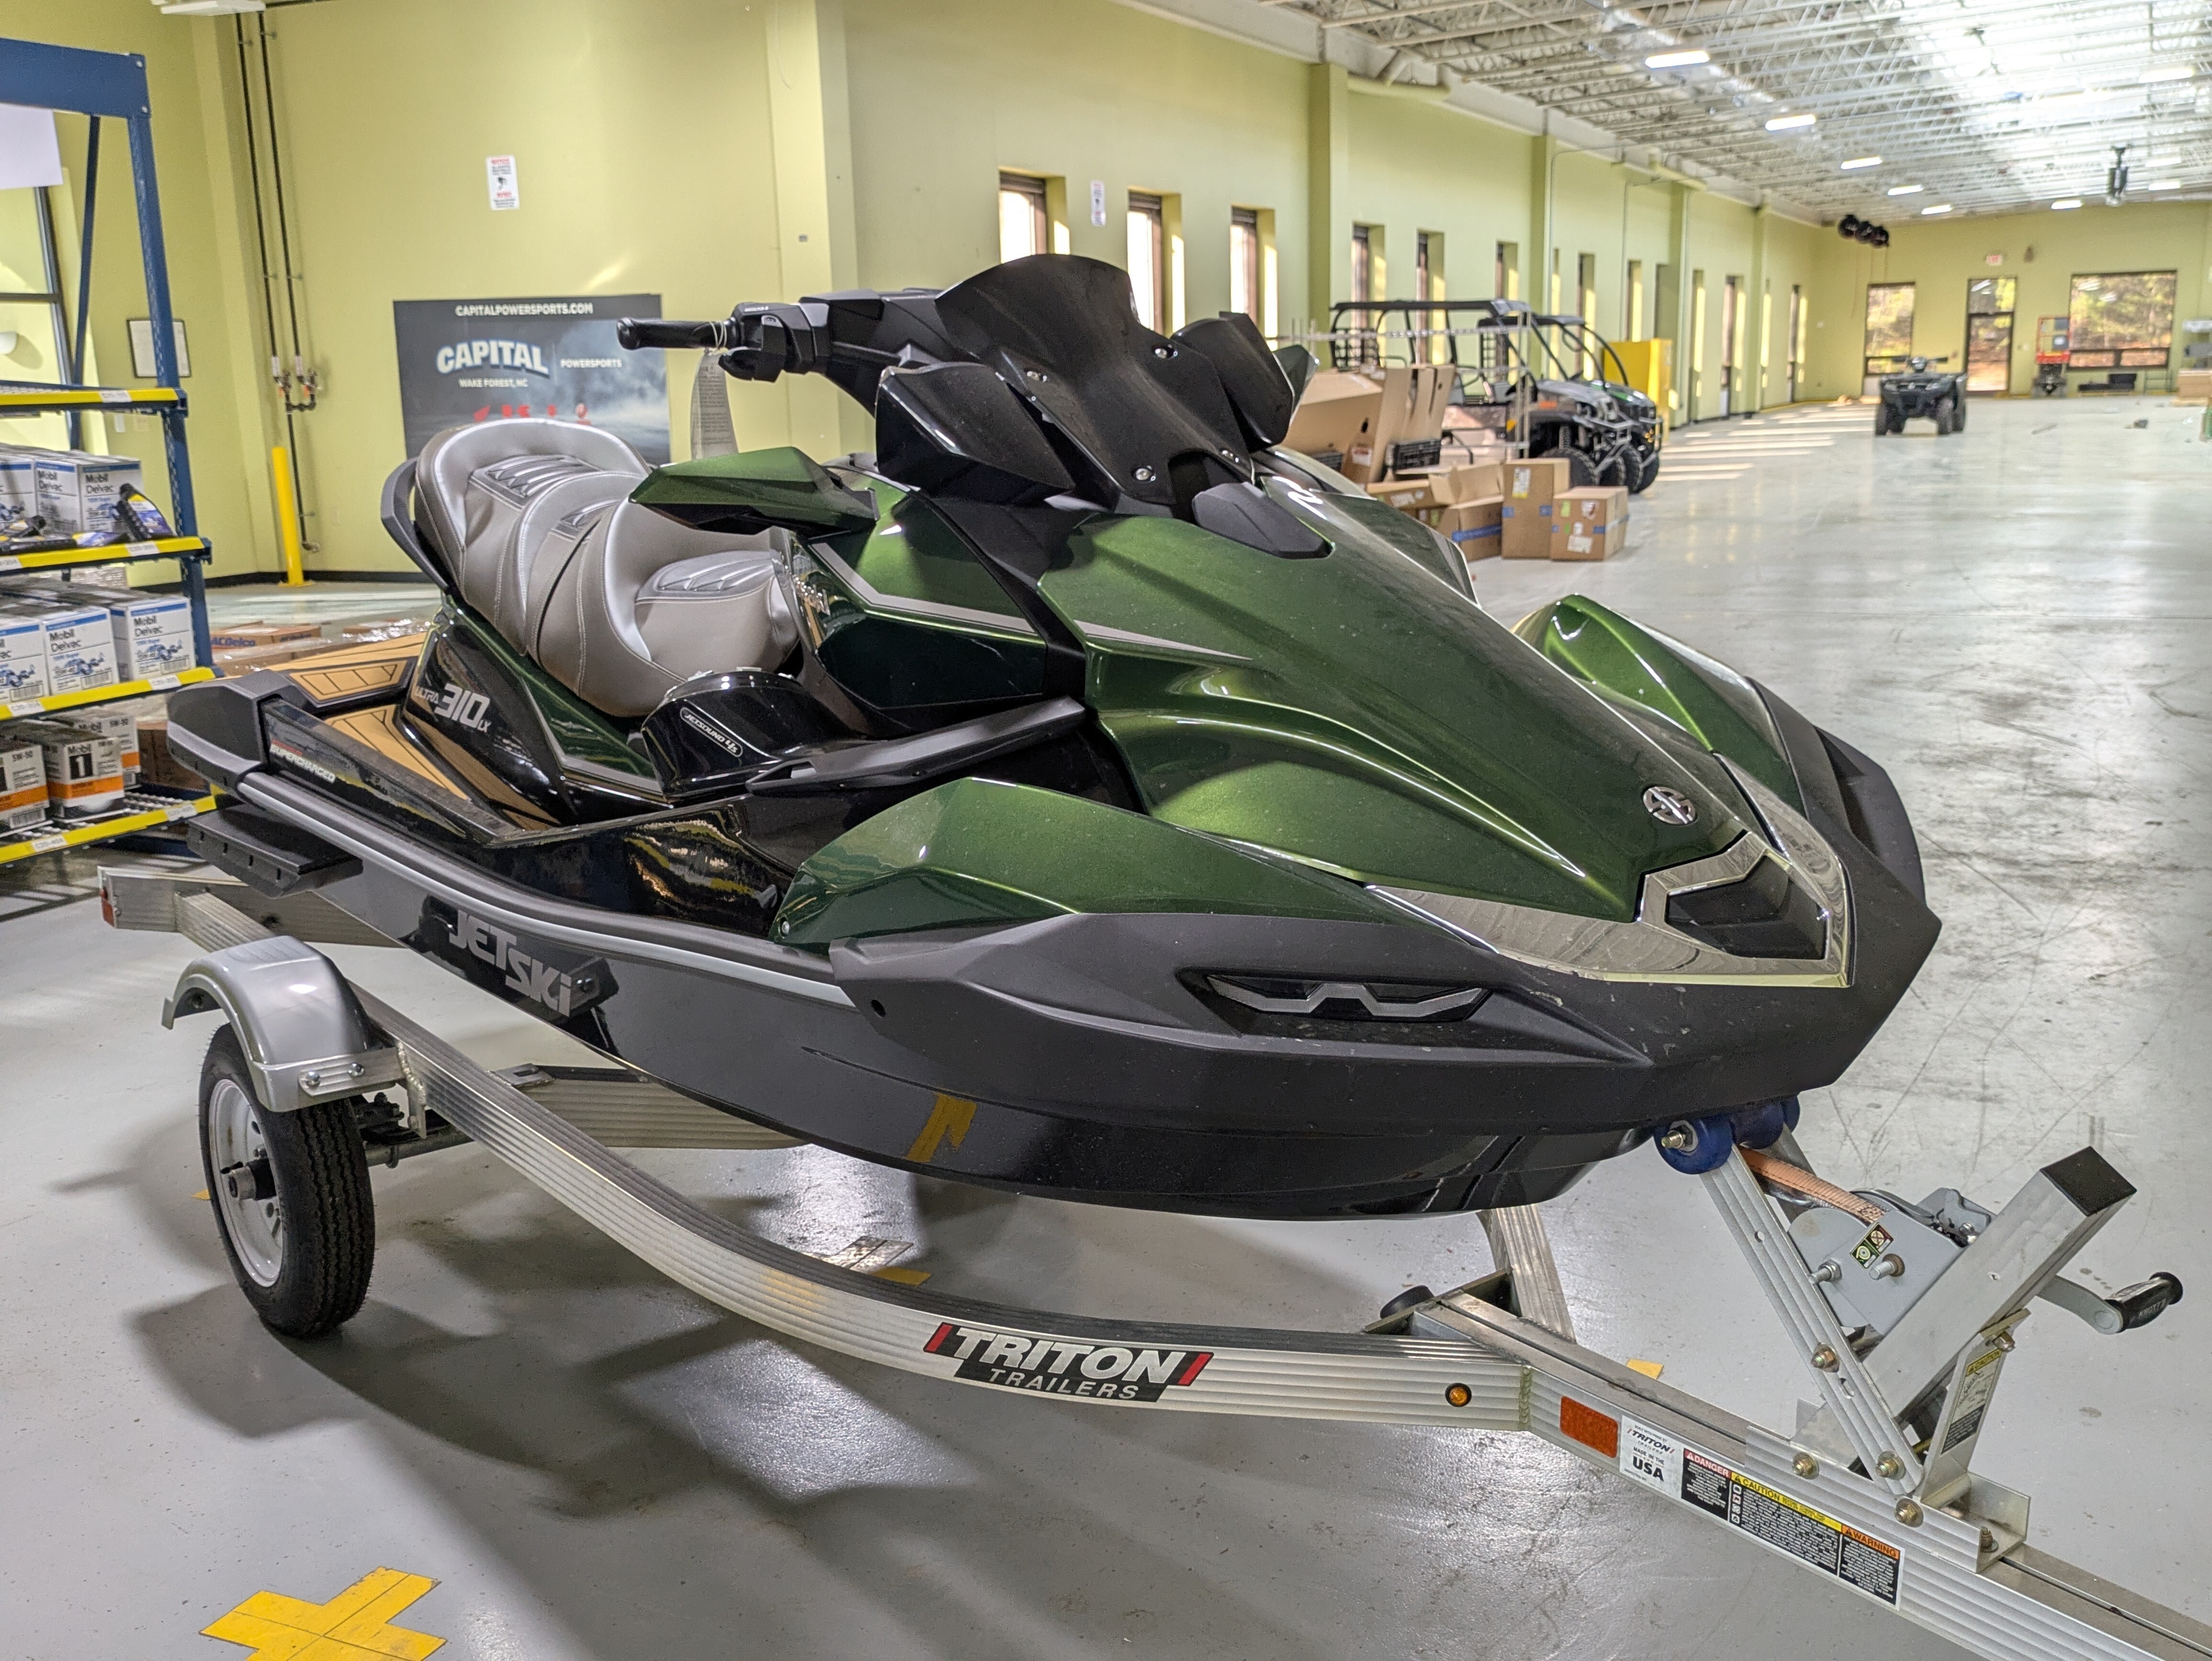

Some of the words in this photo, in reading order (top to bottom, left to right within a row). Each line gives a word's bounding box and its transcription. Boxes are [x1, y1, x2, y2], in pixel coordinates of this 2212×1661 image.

[455, 302, 593, 317] CAPITALPOWERSPORTS.COM
[436, 340, 550, 378] CAPITAL
[560, 358, 622, 368] POWERSPORTS
[458, 378, 482, 388] WAKE
[484, 378, 516, 388] FOREST,
[516, 377, 528, 388] NC
[38, 470, 58, 481] Mobil
[85, 473, 109, 483] Mobil
[38, 479, 63, 492] Delvac
[86, 485, 115, 494] Delvac
[133, 615, 157, 626] Mobil
[49, 629, 76, 641] Mobil
[134, 625, 163, 637] Delvac
[50, 639, 81, 653] Delvac
[434, 683, 490, 729] 310
[684, 714, 725, 742] JETSOUND
[67, 742, 91, 754] Mobil
[76, 755, 86, 777] 1
[270, 743, 336, 783] SUPERCHARGED
[953, 1327, 1186, 1384] TRITON
[988, 1367, 1139, 1400] TRAILERS
[1630, 1430, 1670, 1452] TRITON
[1633, 1446, 1647, 1456] MADE
[1654, 1456, 1665, 1465] THE
[1633, 1455, 1665, 1482] USA
[1694, 1455, 1729, 1478] DANGER
[1742, 1477, 1780, 1501] CAUTION
[1854, 1529, 1897, 1558] WARNING
